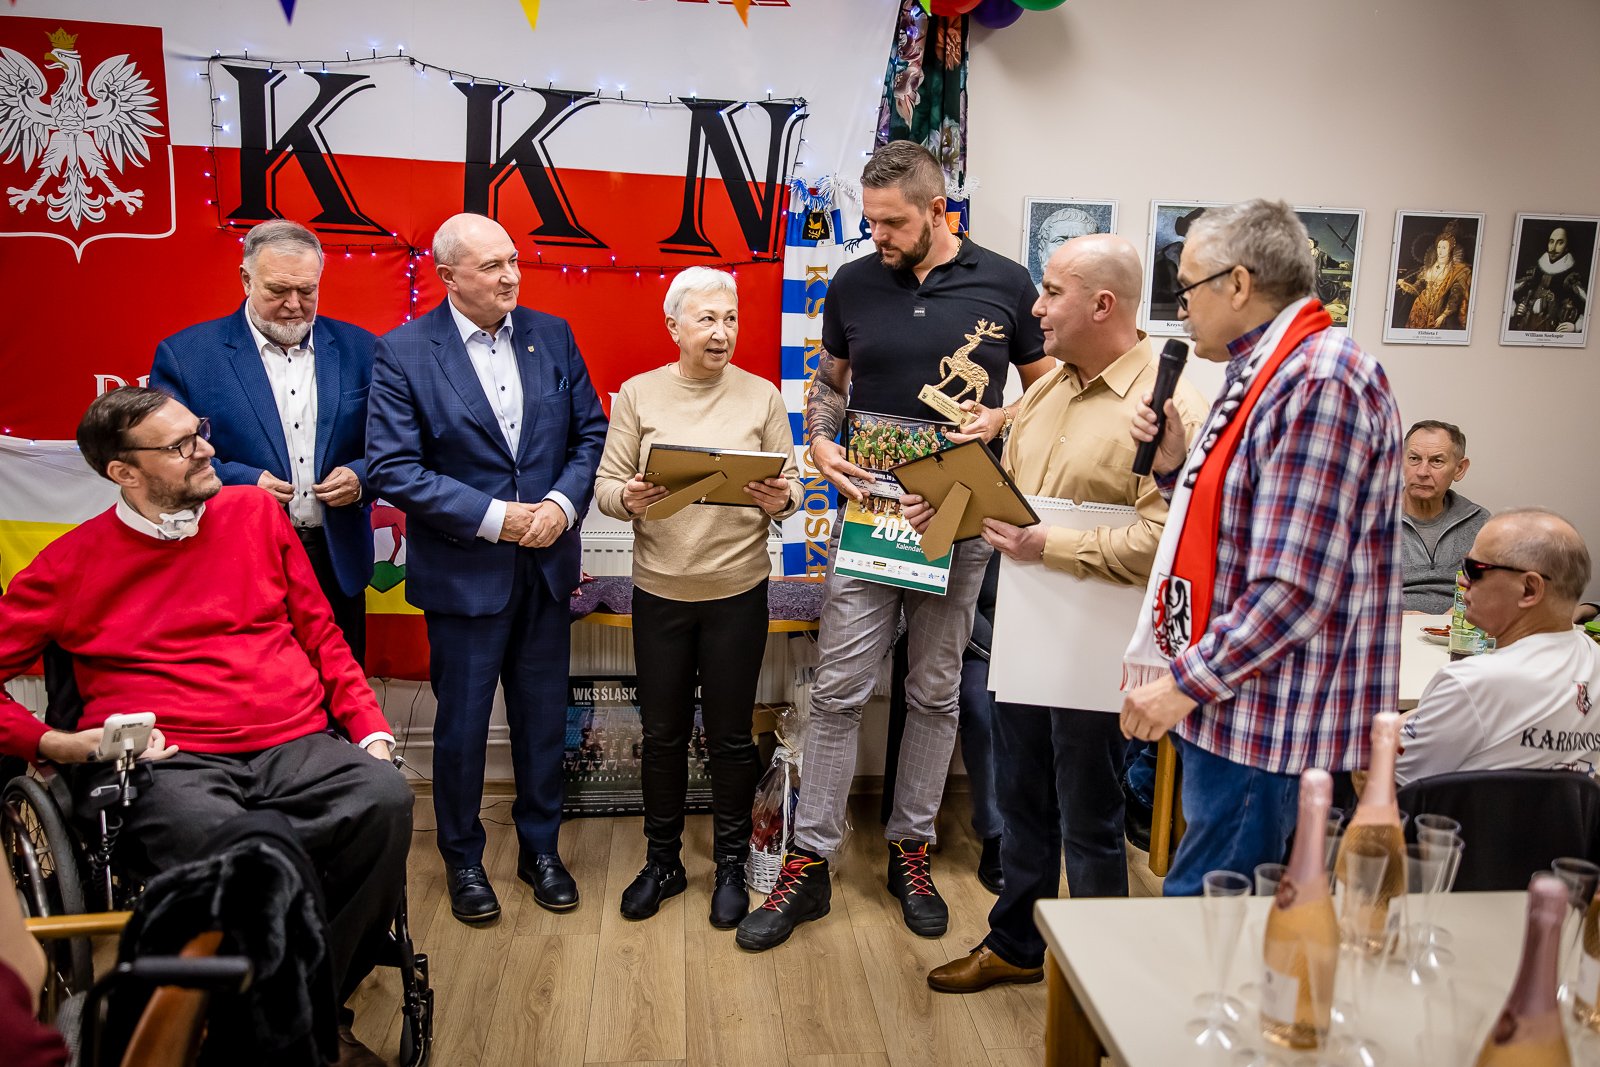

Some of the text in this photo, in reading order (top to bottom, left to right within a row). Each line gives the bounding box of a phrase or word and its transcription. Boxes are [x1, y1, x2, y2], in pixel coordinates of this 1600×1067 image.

[803, 264, 829, 580] KS KNOSZE
[573, 685, 637, 702] WKS ŚLĄSK
